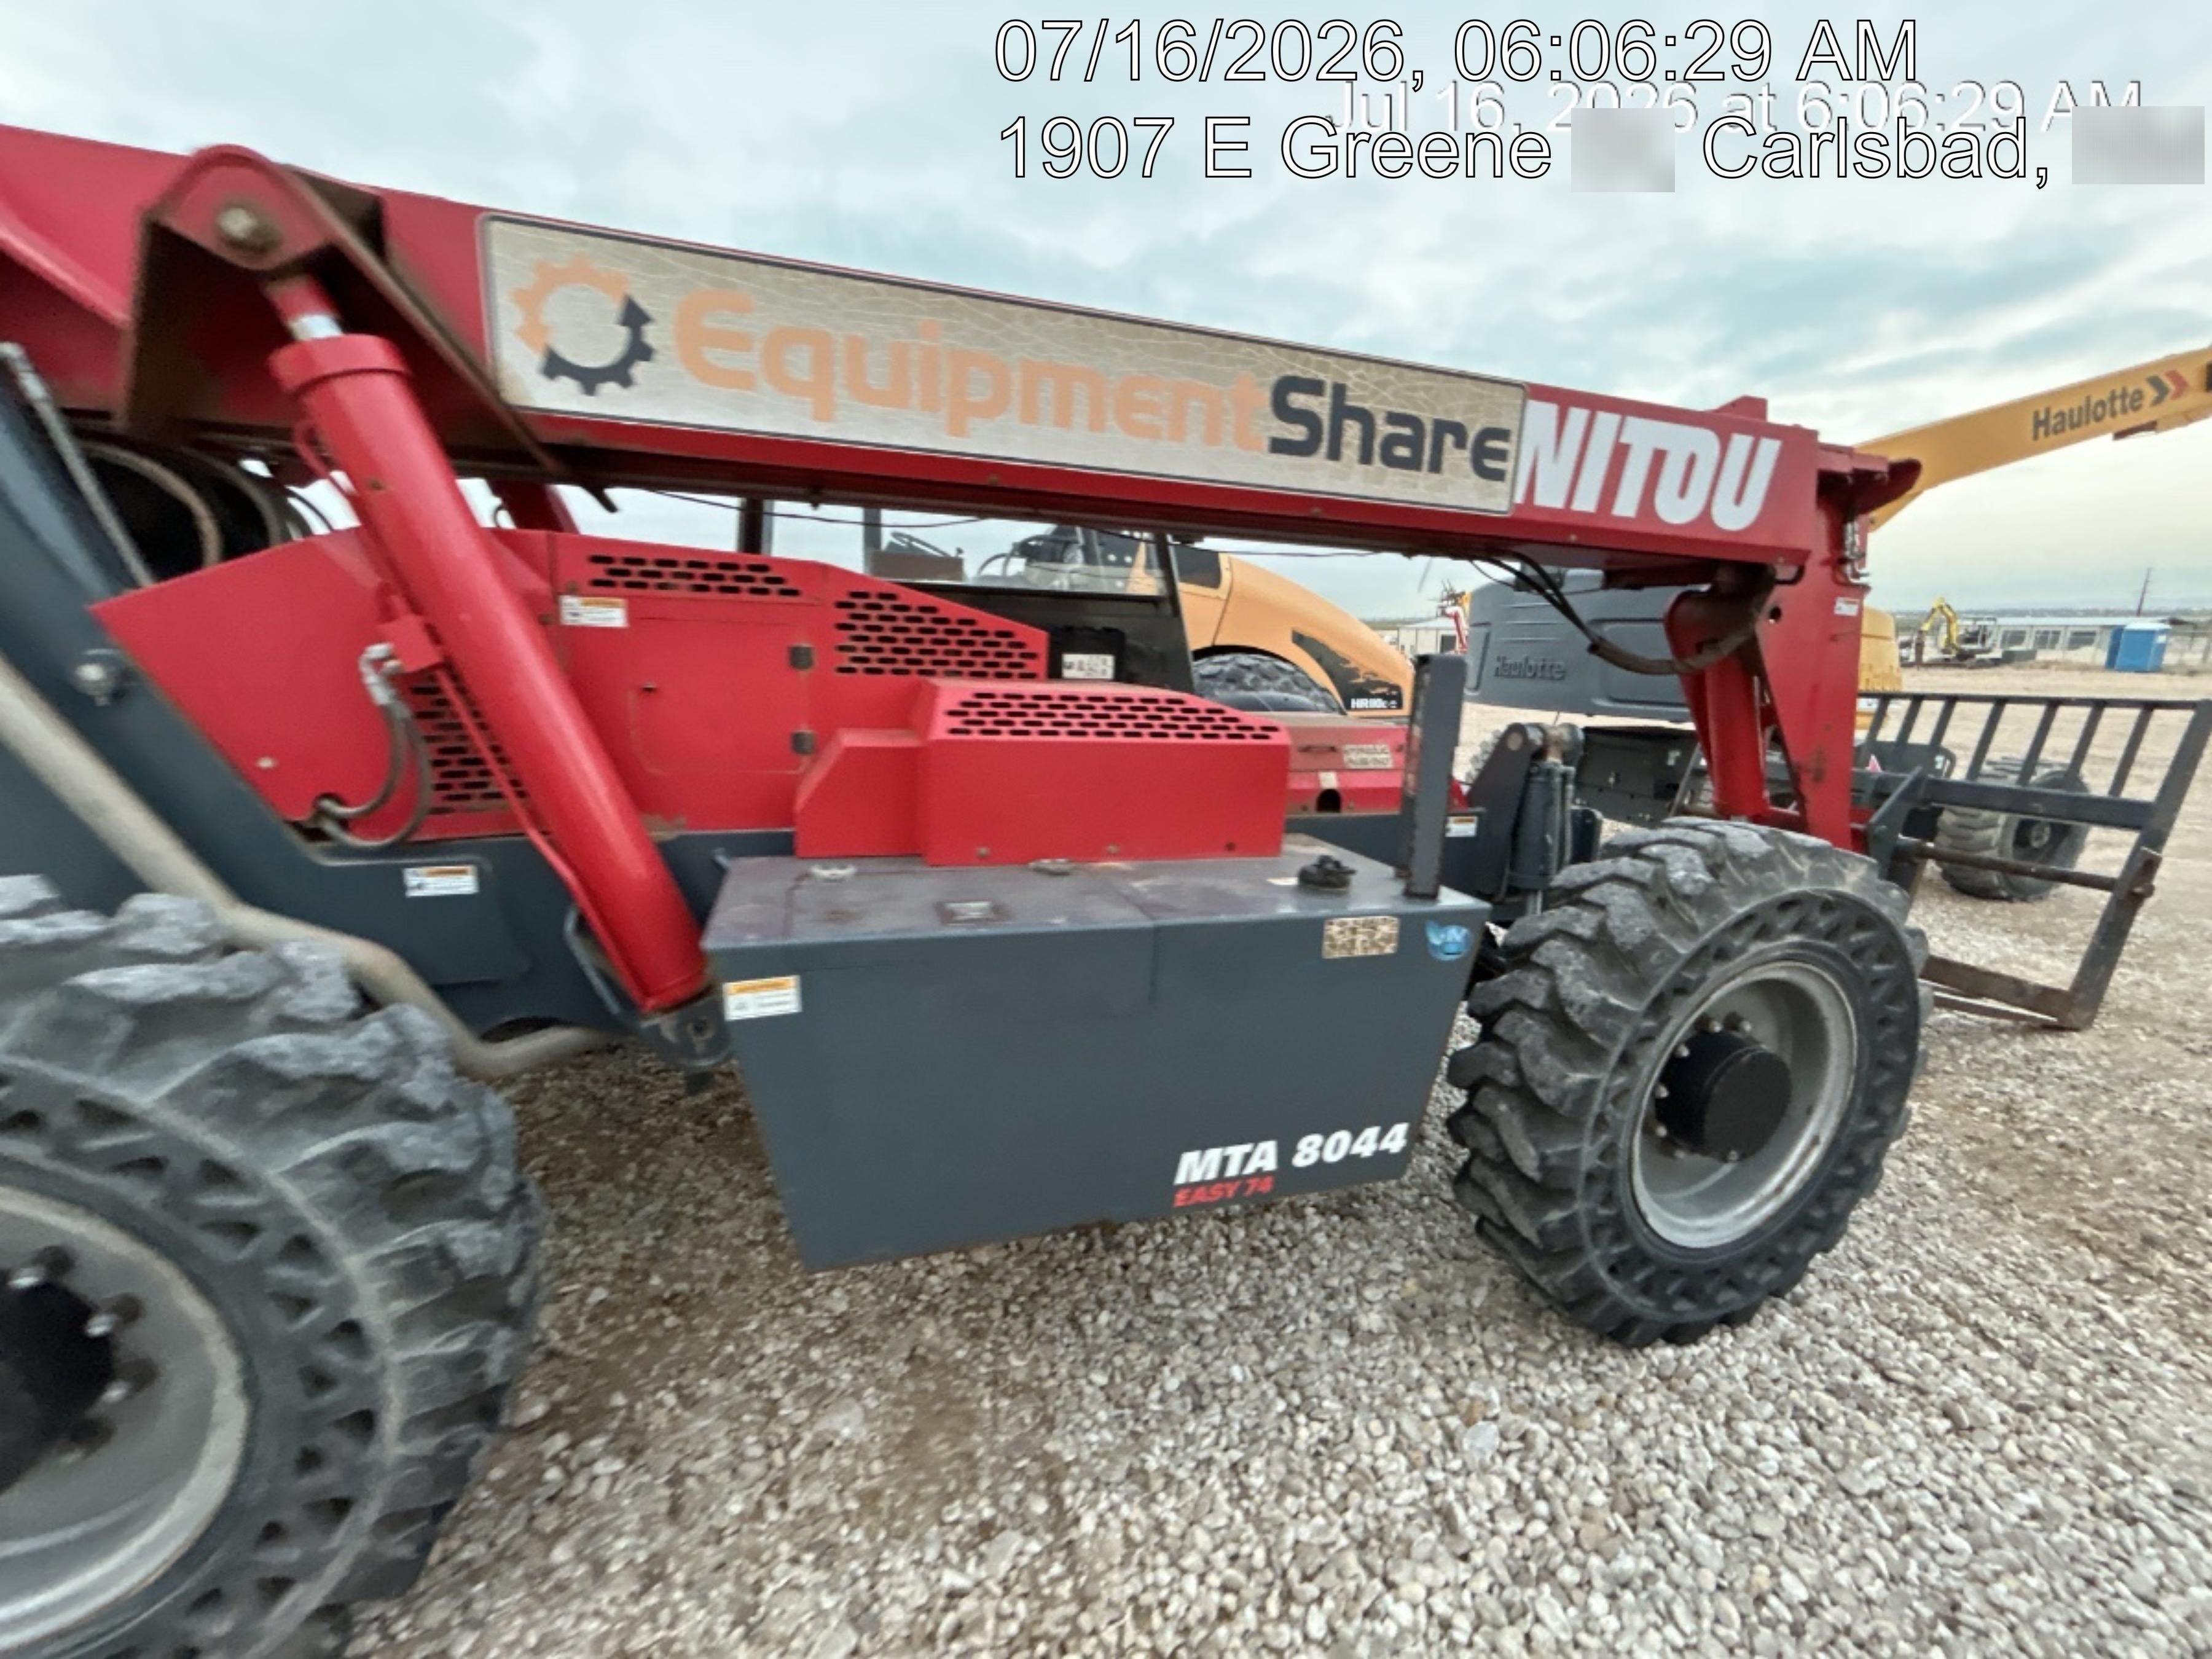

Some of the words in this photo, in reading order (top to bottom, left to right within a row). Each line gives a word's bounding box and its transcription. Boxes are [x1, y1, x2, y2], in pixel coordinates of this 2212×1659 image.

[672, 288, 1513, 482] EquipmentShare
[2032, 386, 2144, 441] Haulotte
[1494, 654, 1566, 681] Haulotte
[1173, 1140, 1278, 1186] MTA
[1292, 1122, 1410, 1168] 8044
[1174, 1180, 1241, 1207] EASY
